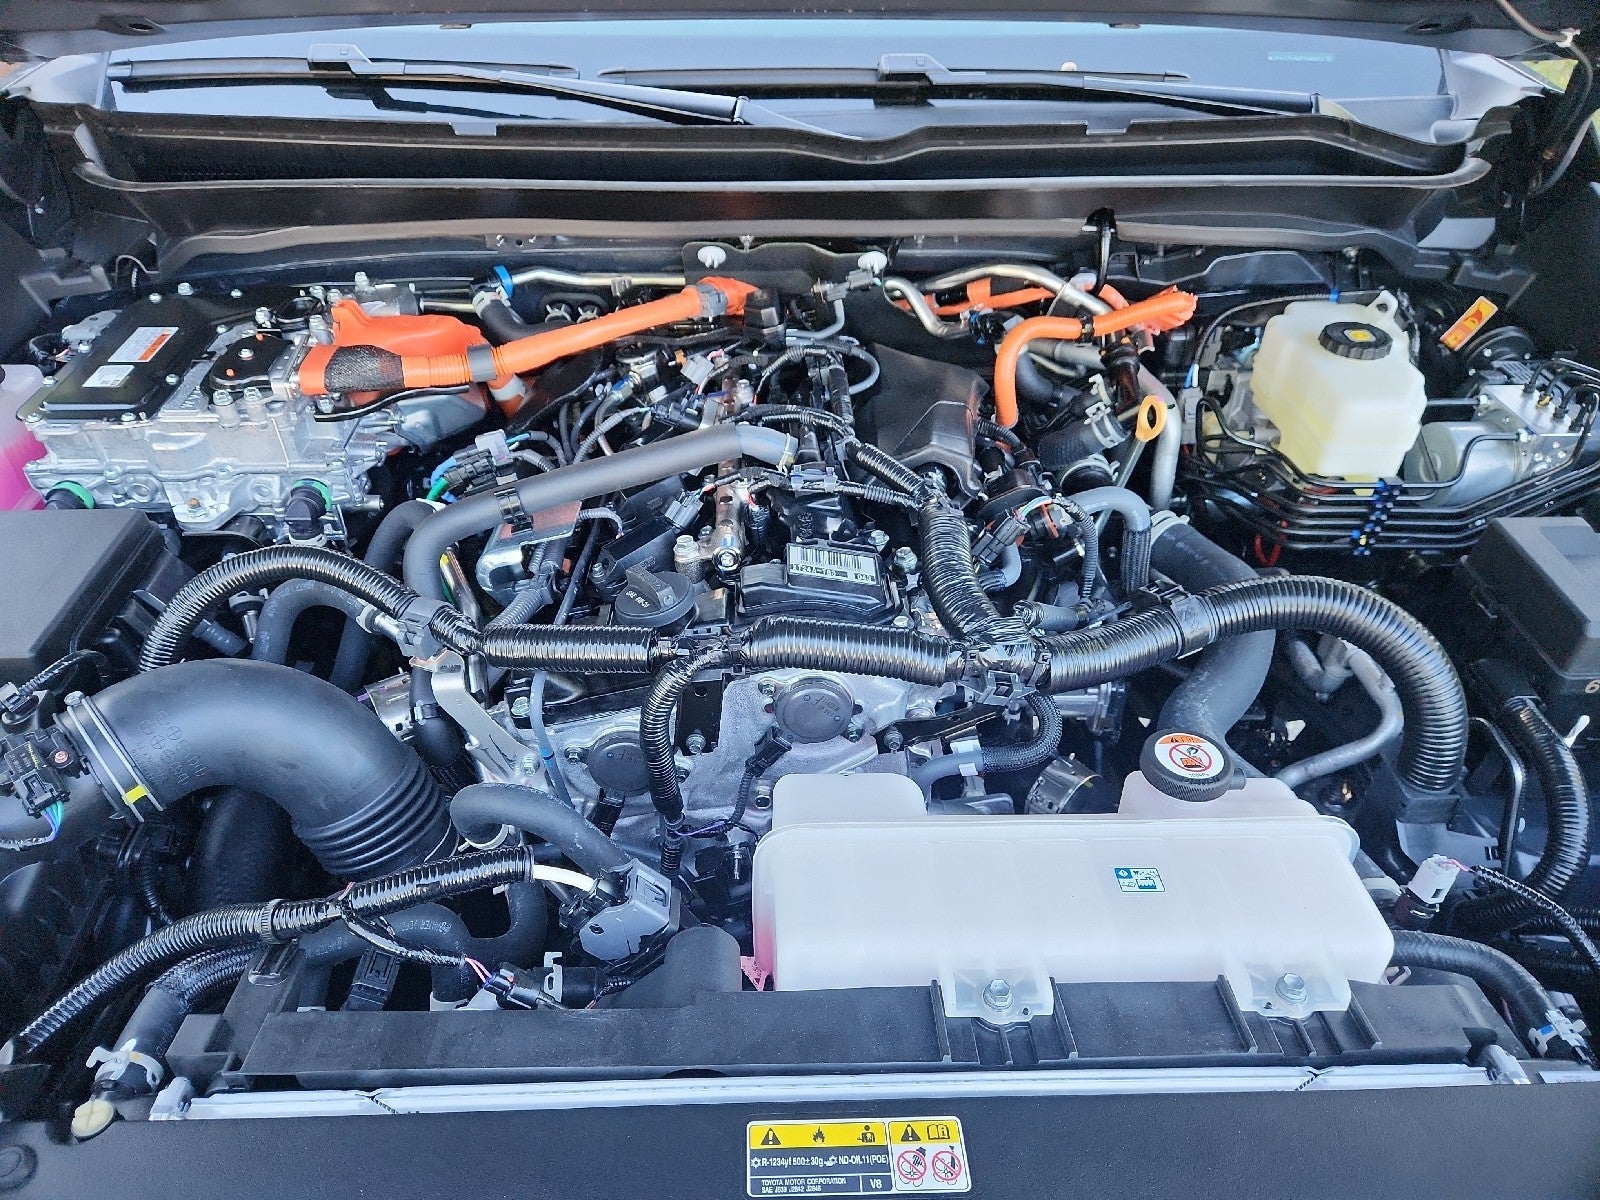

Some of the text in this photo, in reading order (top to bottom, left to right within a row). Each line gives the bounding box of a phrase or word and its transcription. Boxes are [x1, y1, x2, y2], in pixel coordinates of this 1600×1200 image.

[761, 1157, 792, 1168] R-1234yf
[793, 1156, 824, 1167] 500±30g
[761, 1177, 847, 1187] TOYOTA MOTOR CORPORATION
[869, 1178, 883, 1189] V8
[761, 1186, 774, 1194] SAE
